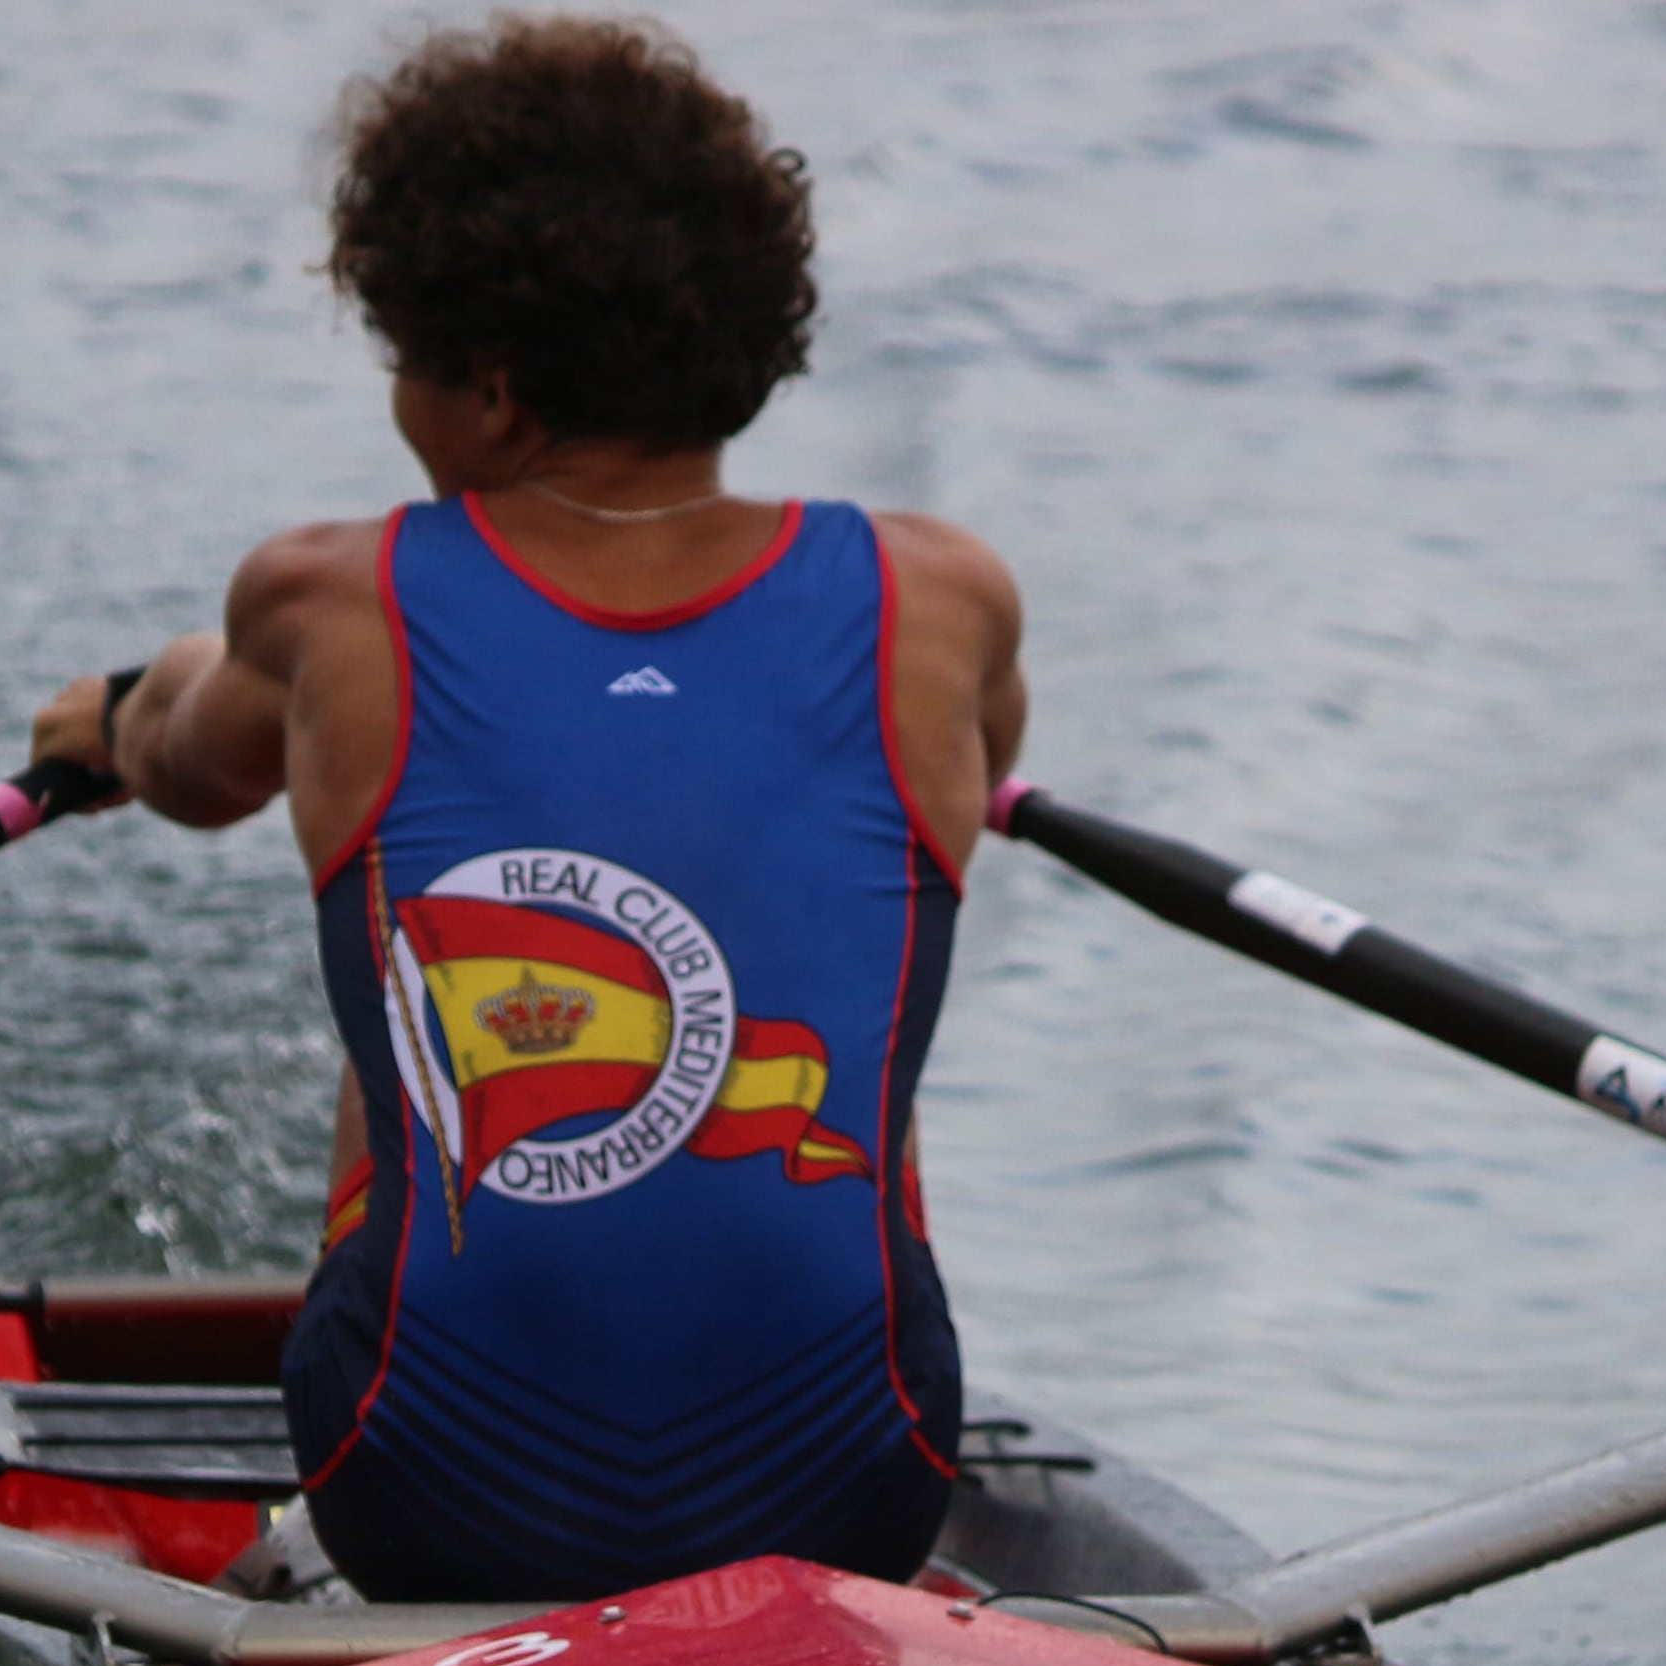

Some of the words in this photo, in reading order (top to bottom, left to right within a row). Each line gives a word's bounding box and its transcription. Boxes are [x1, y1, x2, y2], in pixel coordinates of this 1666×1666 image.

[500, 858, 600, 907] REAL
[614, 886, 711, 982] CLUB
[498, 988, 724, 1195] MEDITERRANEO
